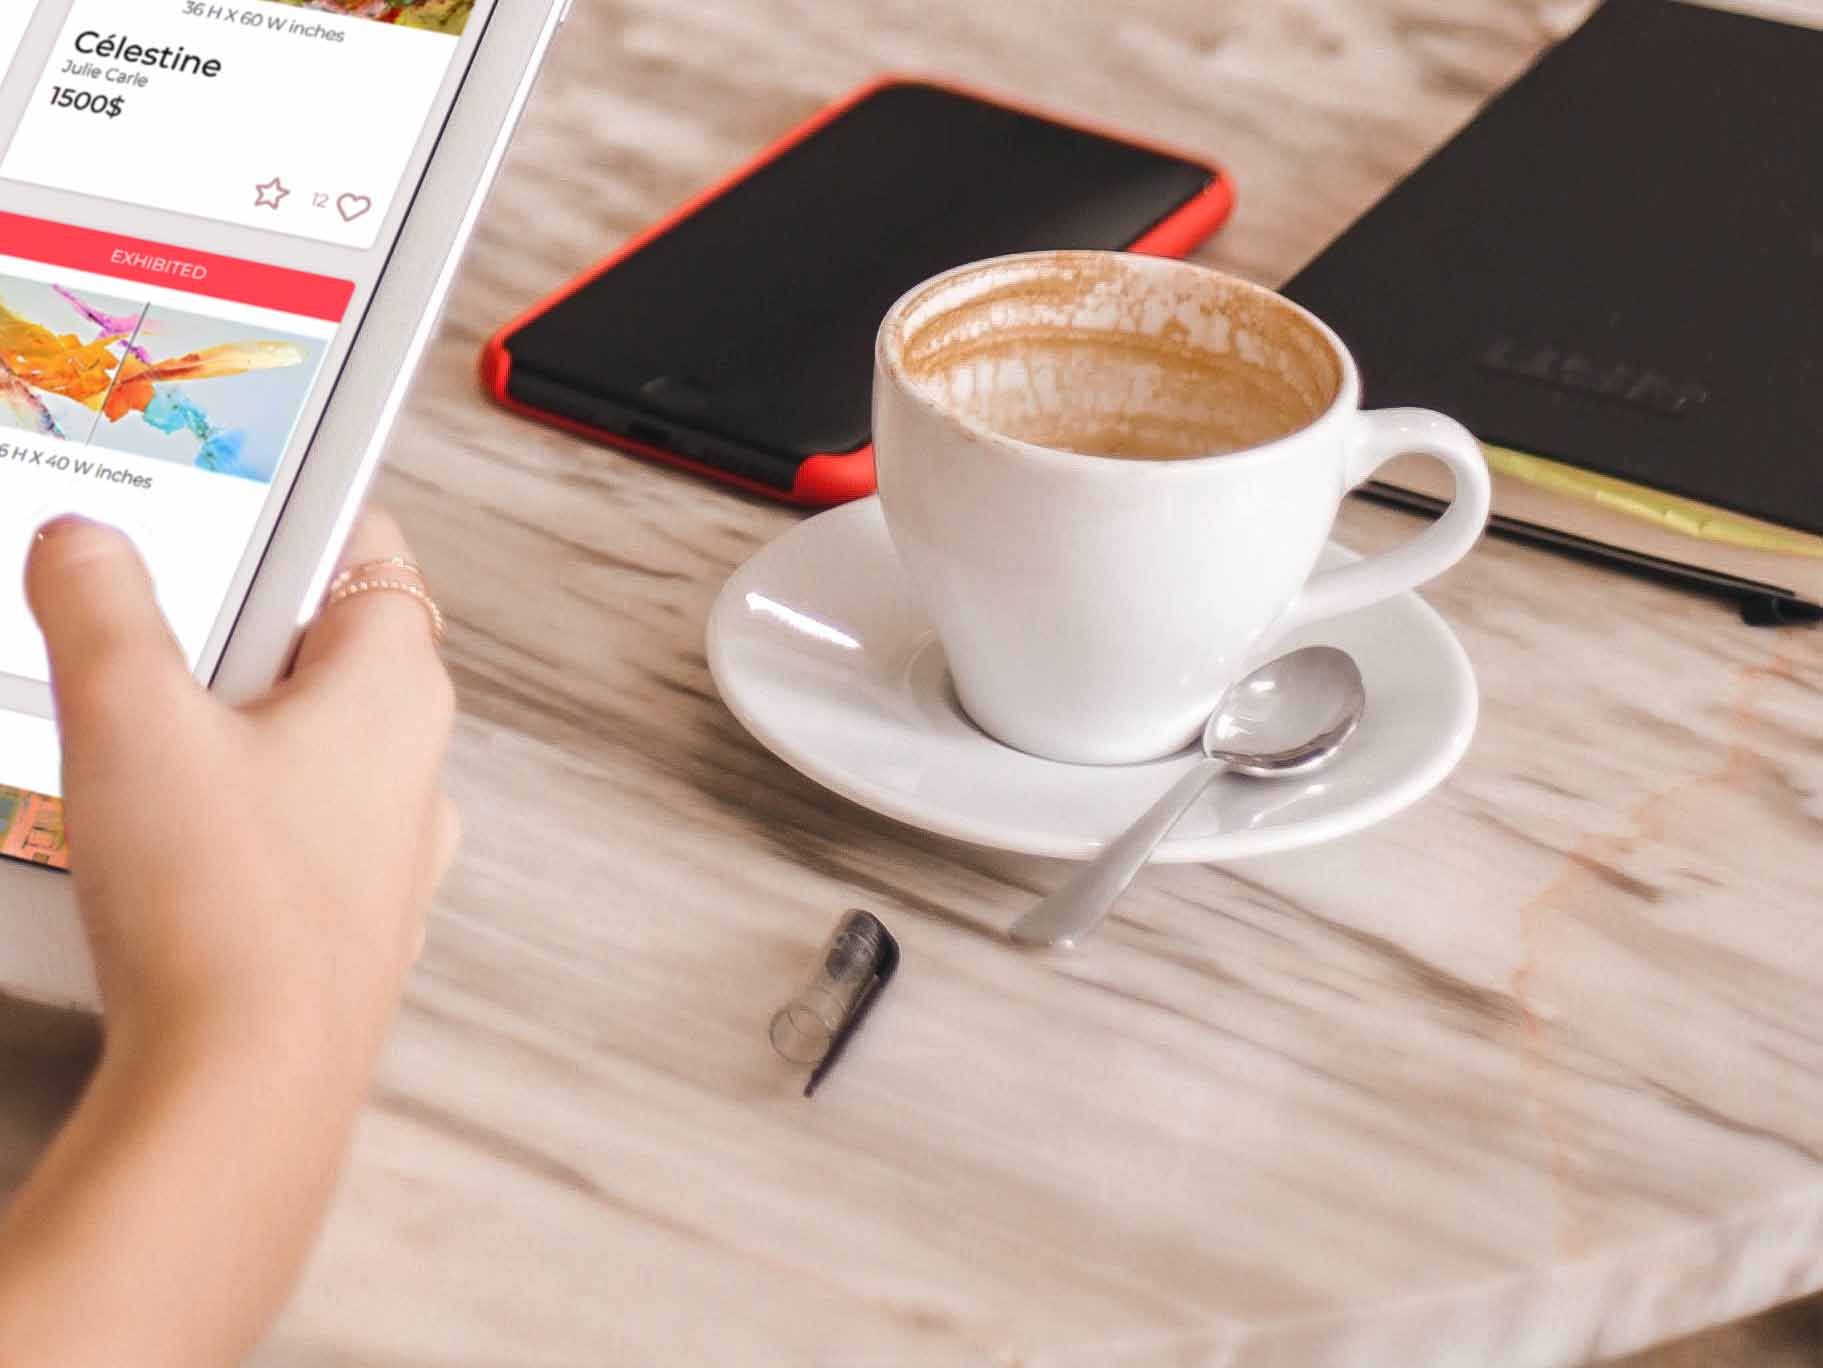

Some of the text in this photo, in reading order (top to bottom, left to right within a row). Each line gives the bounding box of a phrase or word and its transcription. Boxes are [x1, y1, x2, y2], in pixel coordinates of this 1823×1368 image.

[182, 0, 346, 42] 36 H X 60 W inches
[74, 30, 222, 78] Célestine
[61, 60, 148, 87] Julie Carle
[50, 86, 125, 118] 1500$
[311, 192, 329, 208] 12
[110, 248, 207, 281] EXHIBITED
[11, 446, 28, 462] H
[27, 450, 44, 465] X
[45, 454, 70, 471] 40
[73, 459, 96, 475] W
[95, 462, 153, 489] inches
